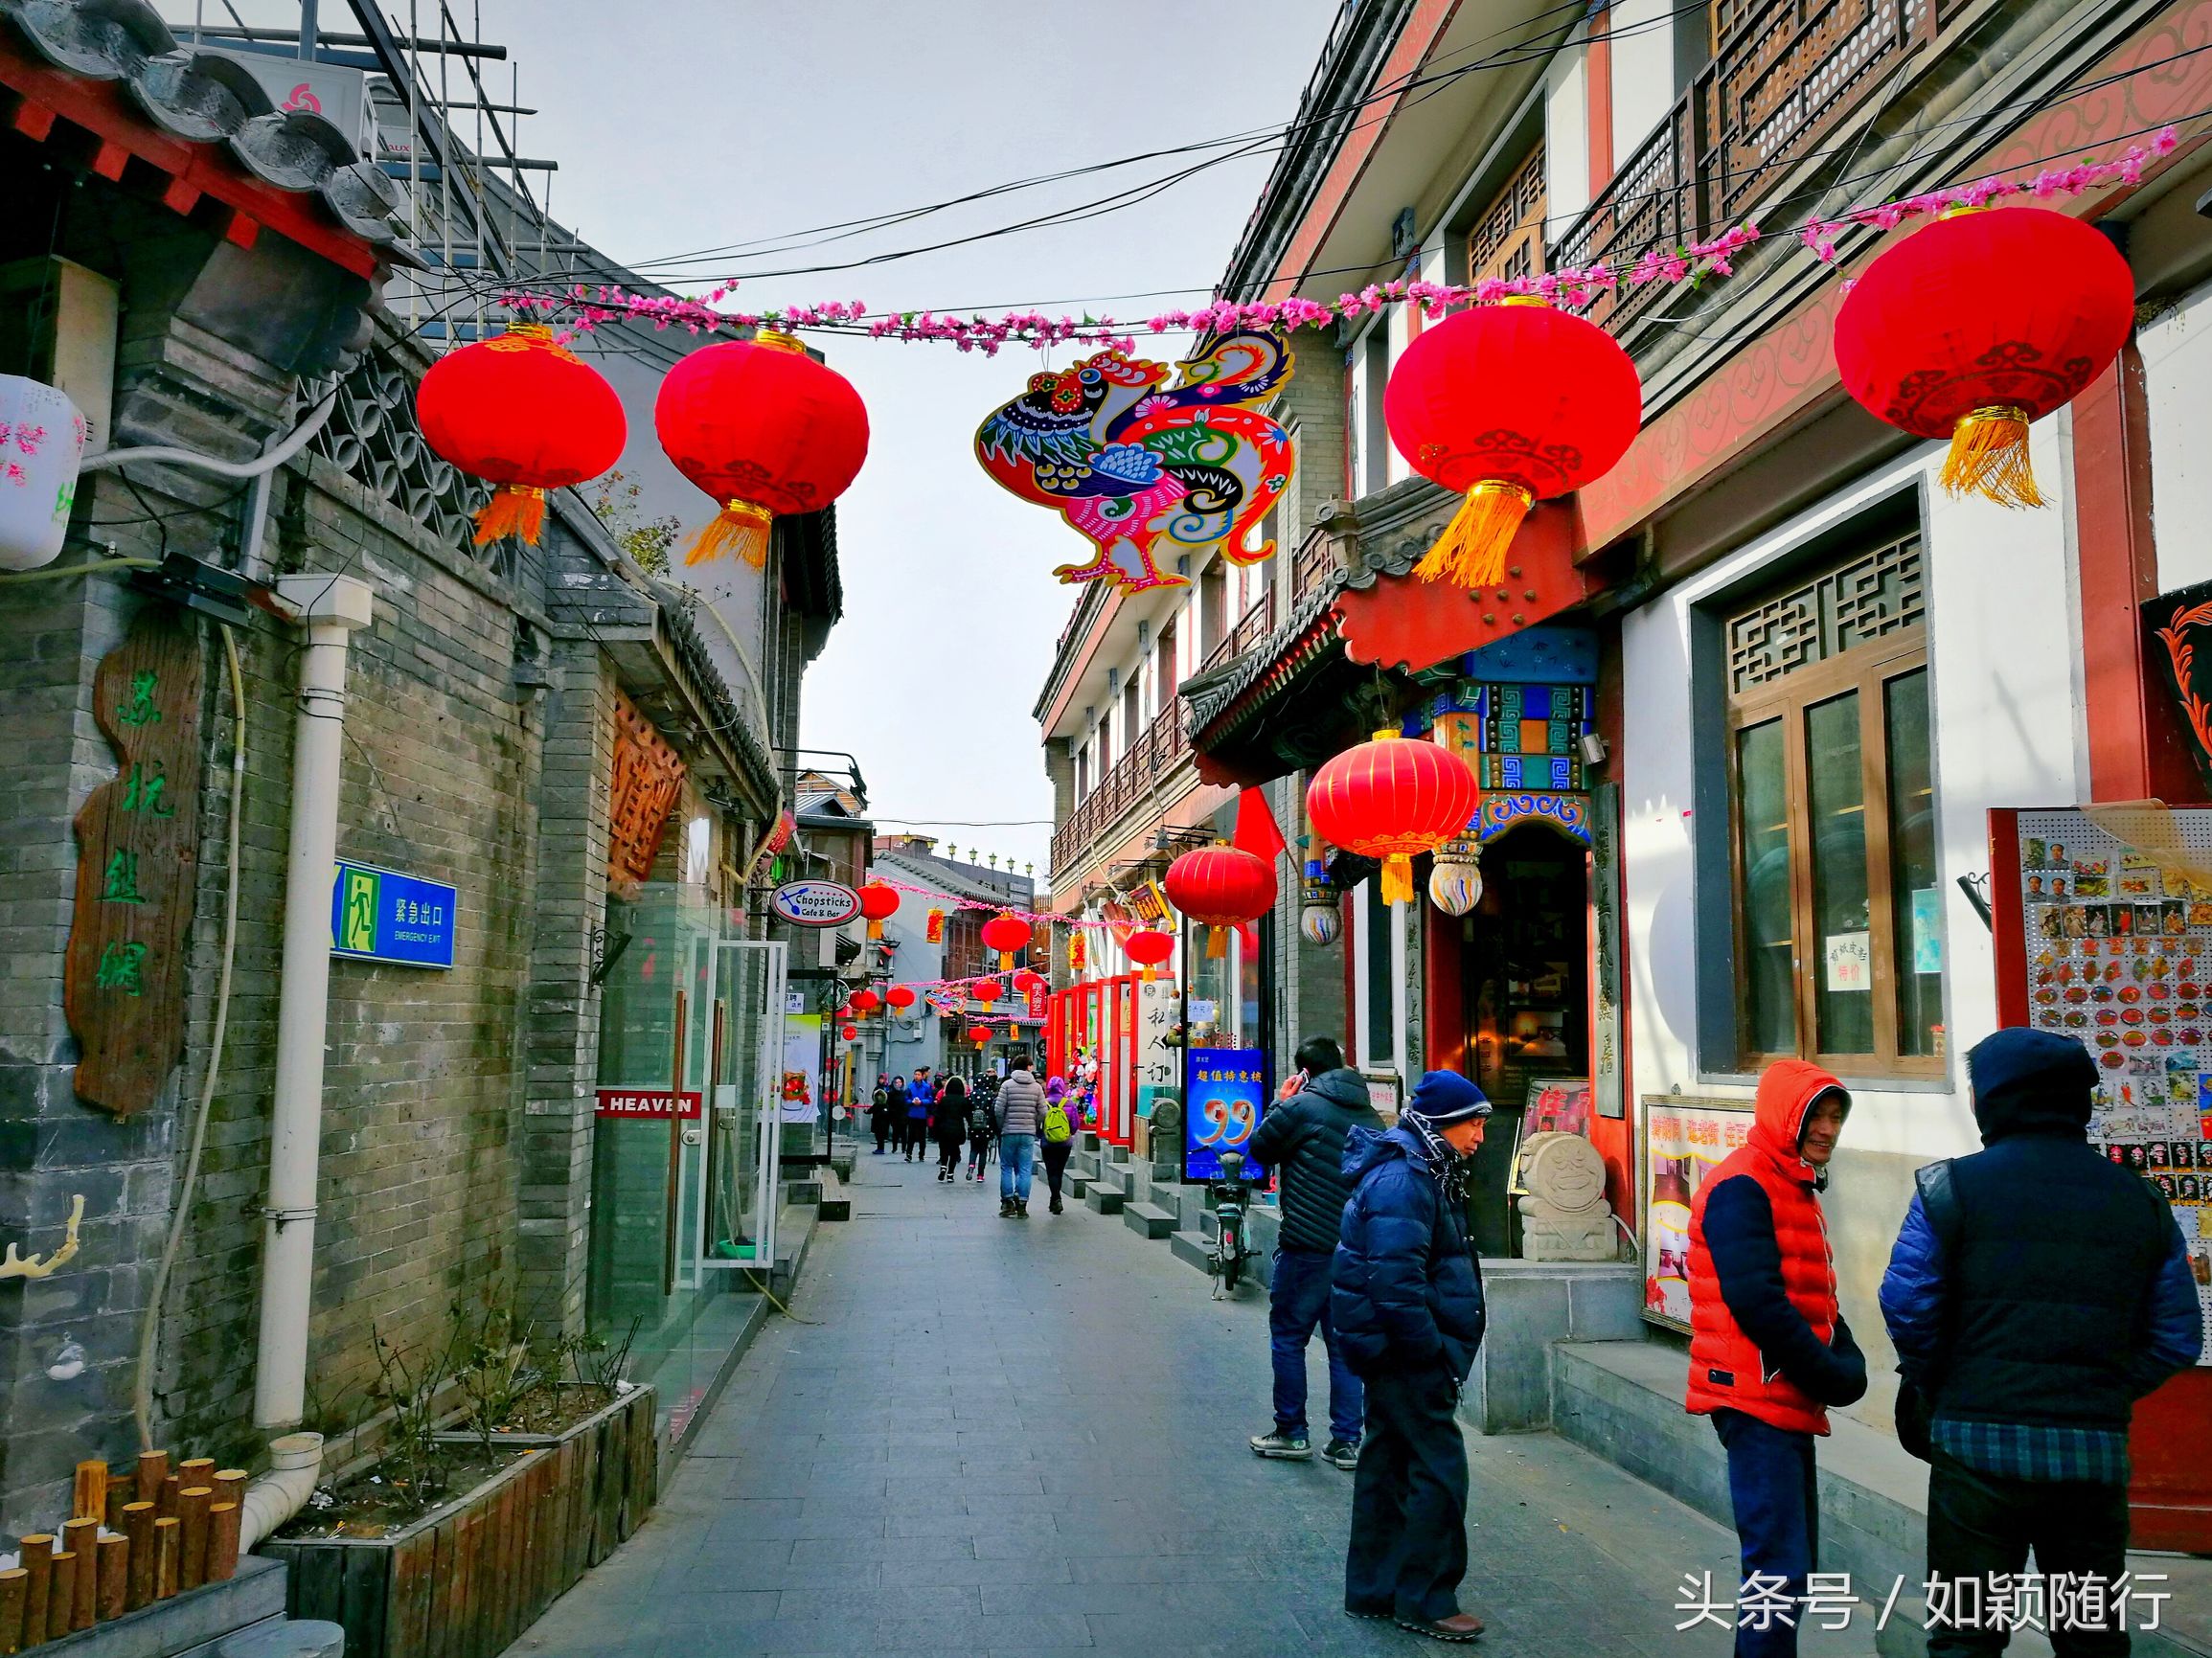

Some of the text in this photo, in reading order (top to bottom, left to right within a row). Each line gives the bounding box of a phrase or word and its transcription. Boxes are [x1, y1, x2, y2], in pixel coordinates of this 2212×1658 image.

[796, 895, 852, 908] Chopsticks
[395, 898, 442, 926] 紧急出口
[802, 908, 817, 917] Cafe
[395, 930, 442, 943] EMERGENCY EXIT
[1838, 965, 1860, 982] 特价
[609, 1097, 692, 1113] HEAVEN
[1194, 1099, 1256, 1147] 99
